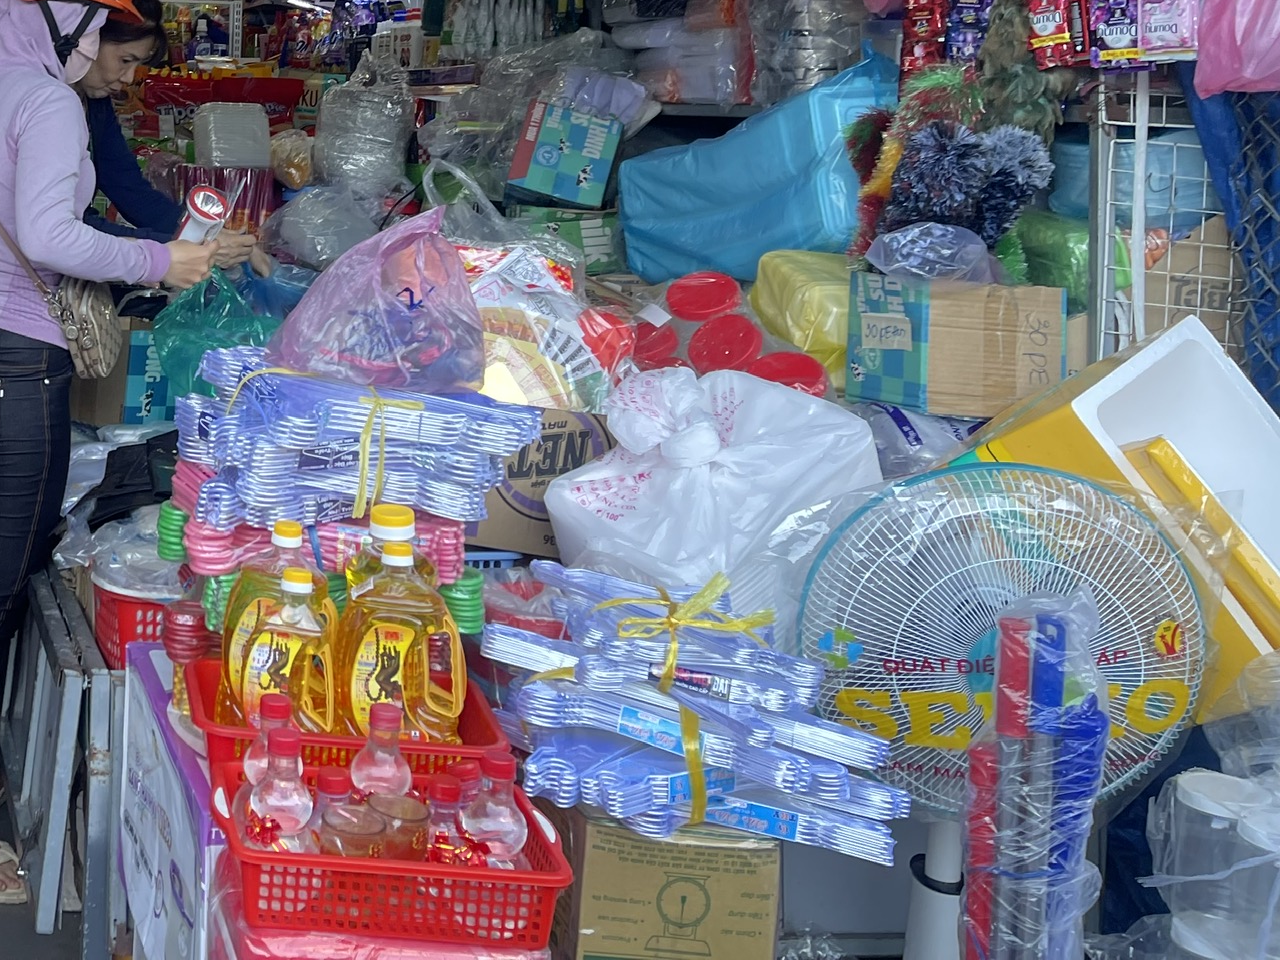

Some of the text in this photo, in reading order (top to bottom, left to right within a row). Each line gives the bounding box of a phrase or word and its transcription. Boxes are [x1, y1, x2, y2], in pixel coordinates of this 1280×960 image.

[1097, 23, 1138, 38] Downy
[1145, 22, 1178, 34] Downy
[504, 430, 592, 479] NET
